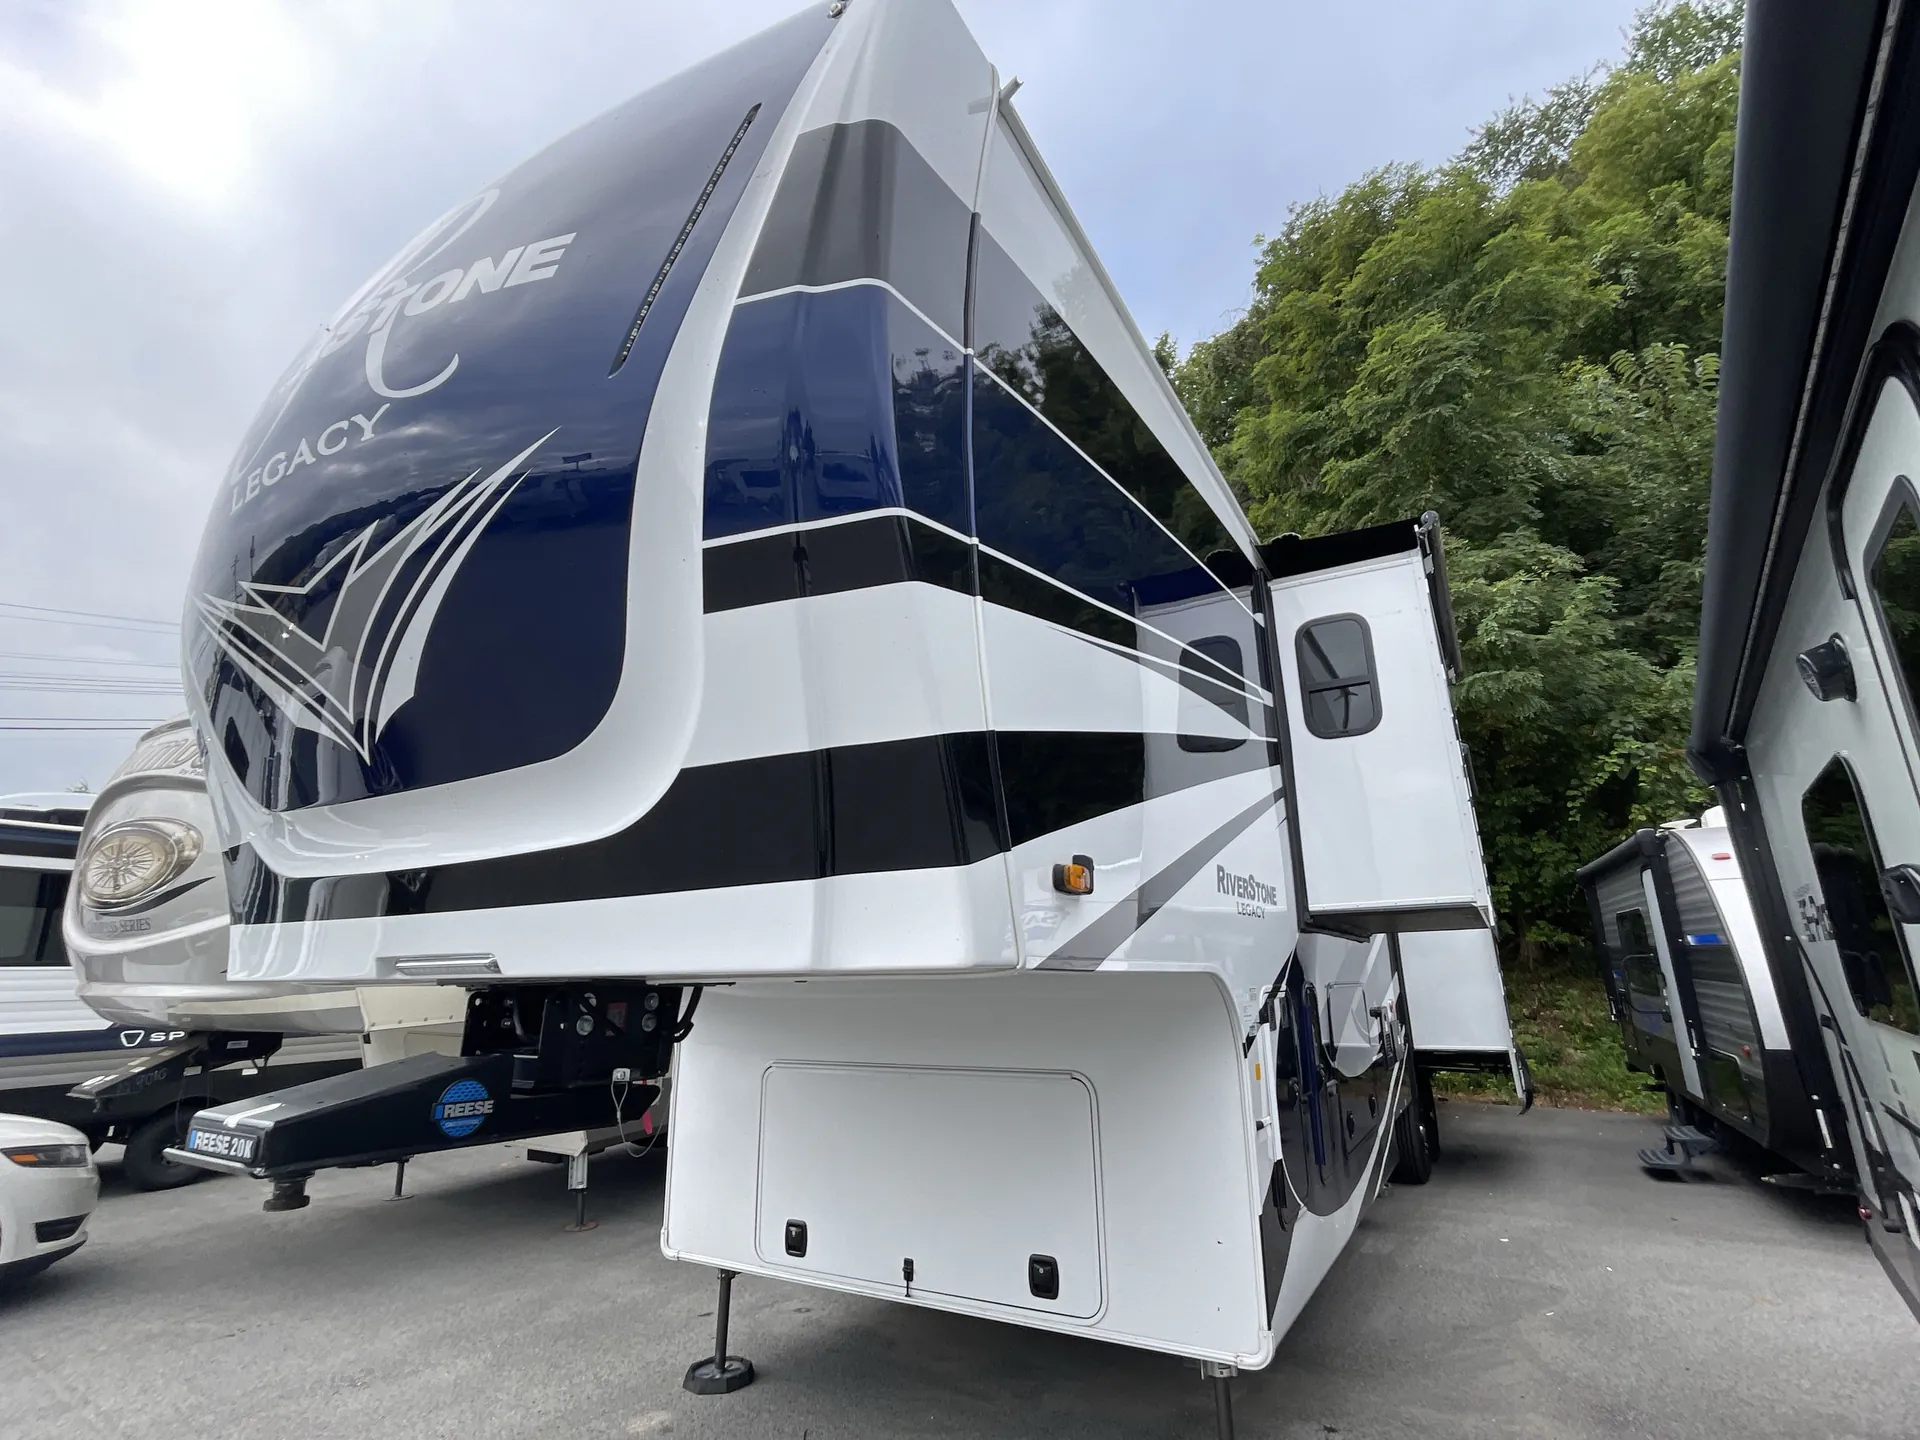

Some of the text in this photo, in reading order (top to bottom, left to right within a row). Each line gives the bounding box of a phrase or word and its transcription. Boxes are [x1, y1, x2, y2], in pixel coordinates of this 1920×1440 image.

[229, 402, 391, 516] LEGACY
[1237, 902, 1266, 919] LEGACY
[120, 917, 152, 933] SERIES
[443, 1099, 495, 1119] REESE
[193, 1130, 254, 1159] REESE 20K
